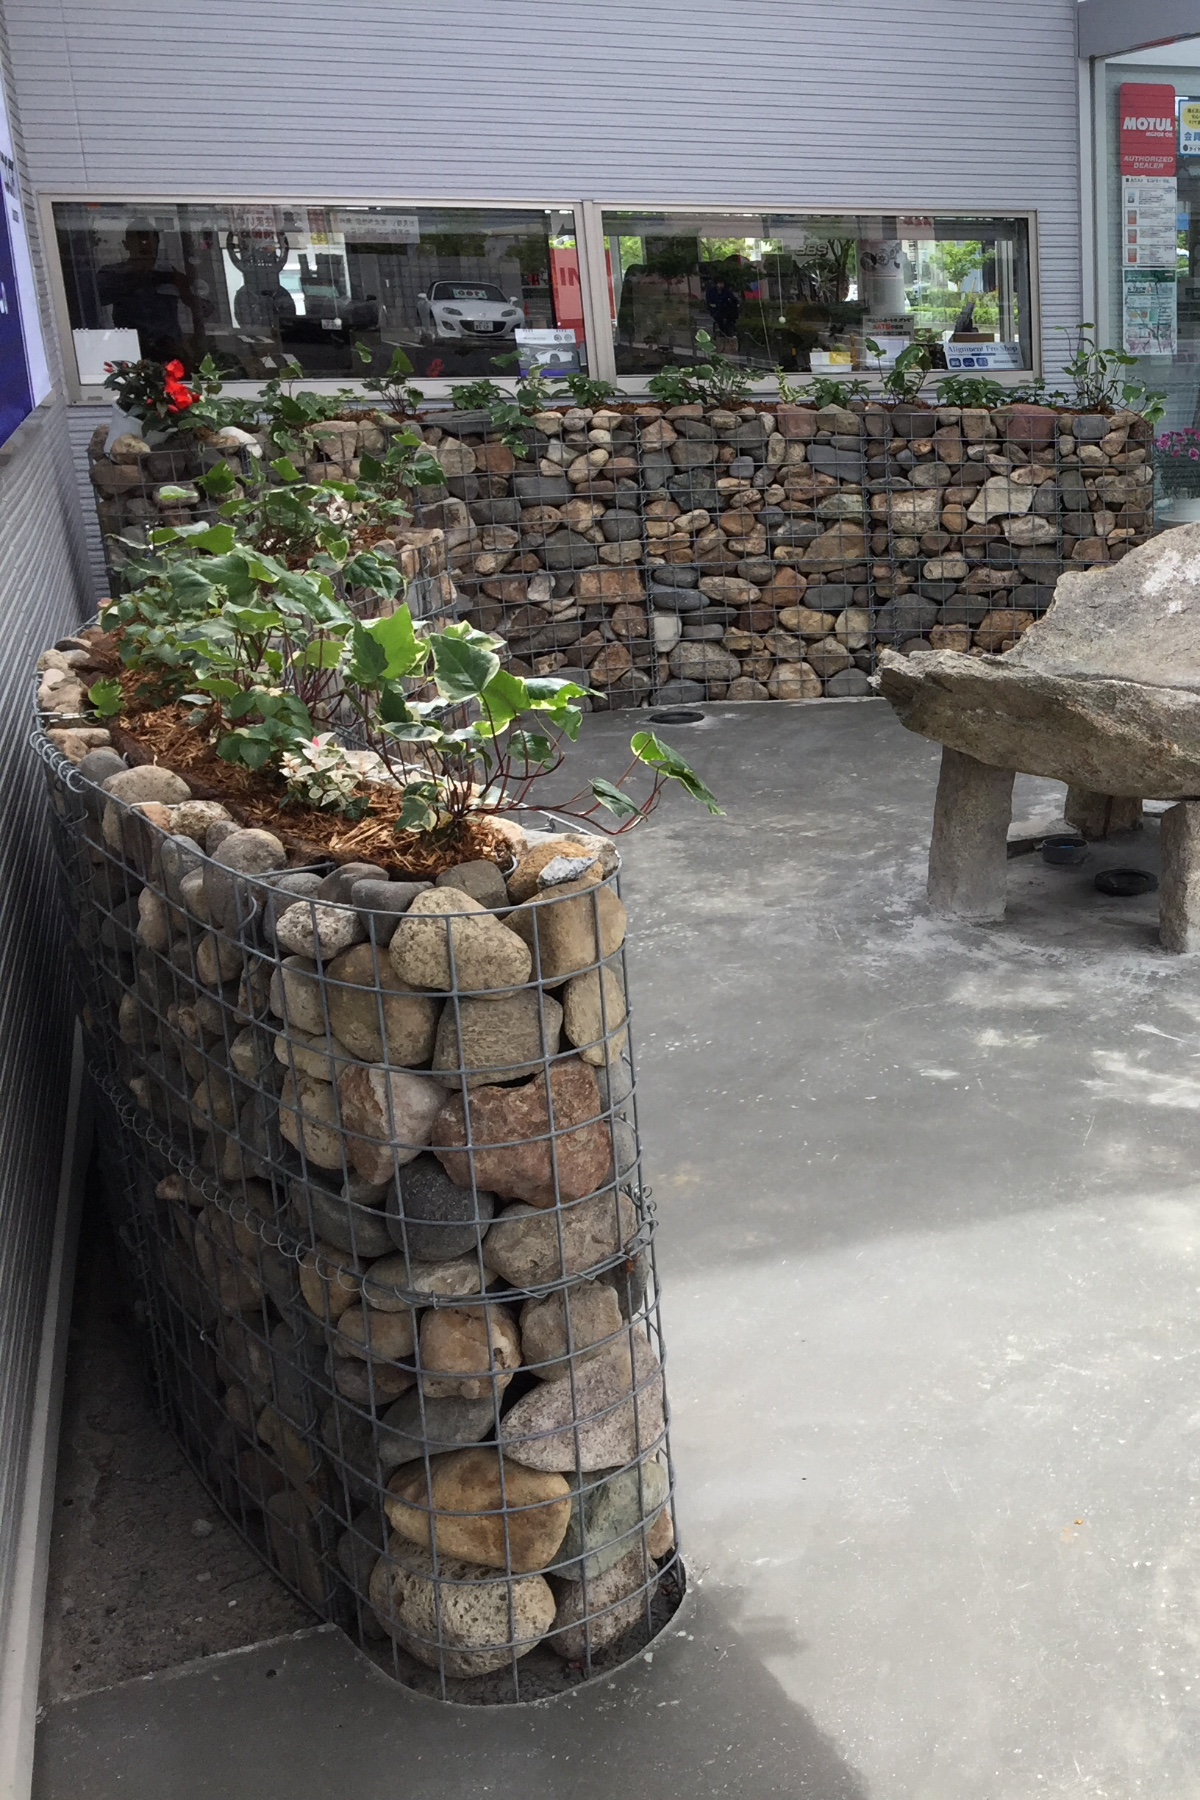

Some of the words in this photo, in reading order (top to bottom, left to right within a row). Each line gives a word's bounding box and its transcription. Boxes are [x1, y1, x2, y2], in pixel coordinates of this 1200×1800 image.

[1123, 116, 1173, 131] MOTUL
[1123, 155, 1174, 163] AUTHORIZED
[947, 345, 984, 354] Alignment
